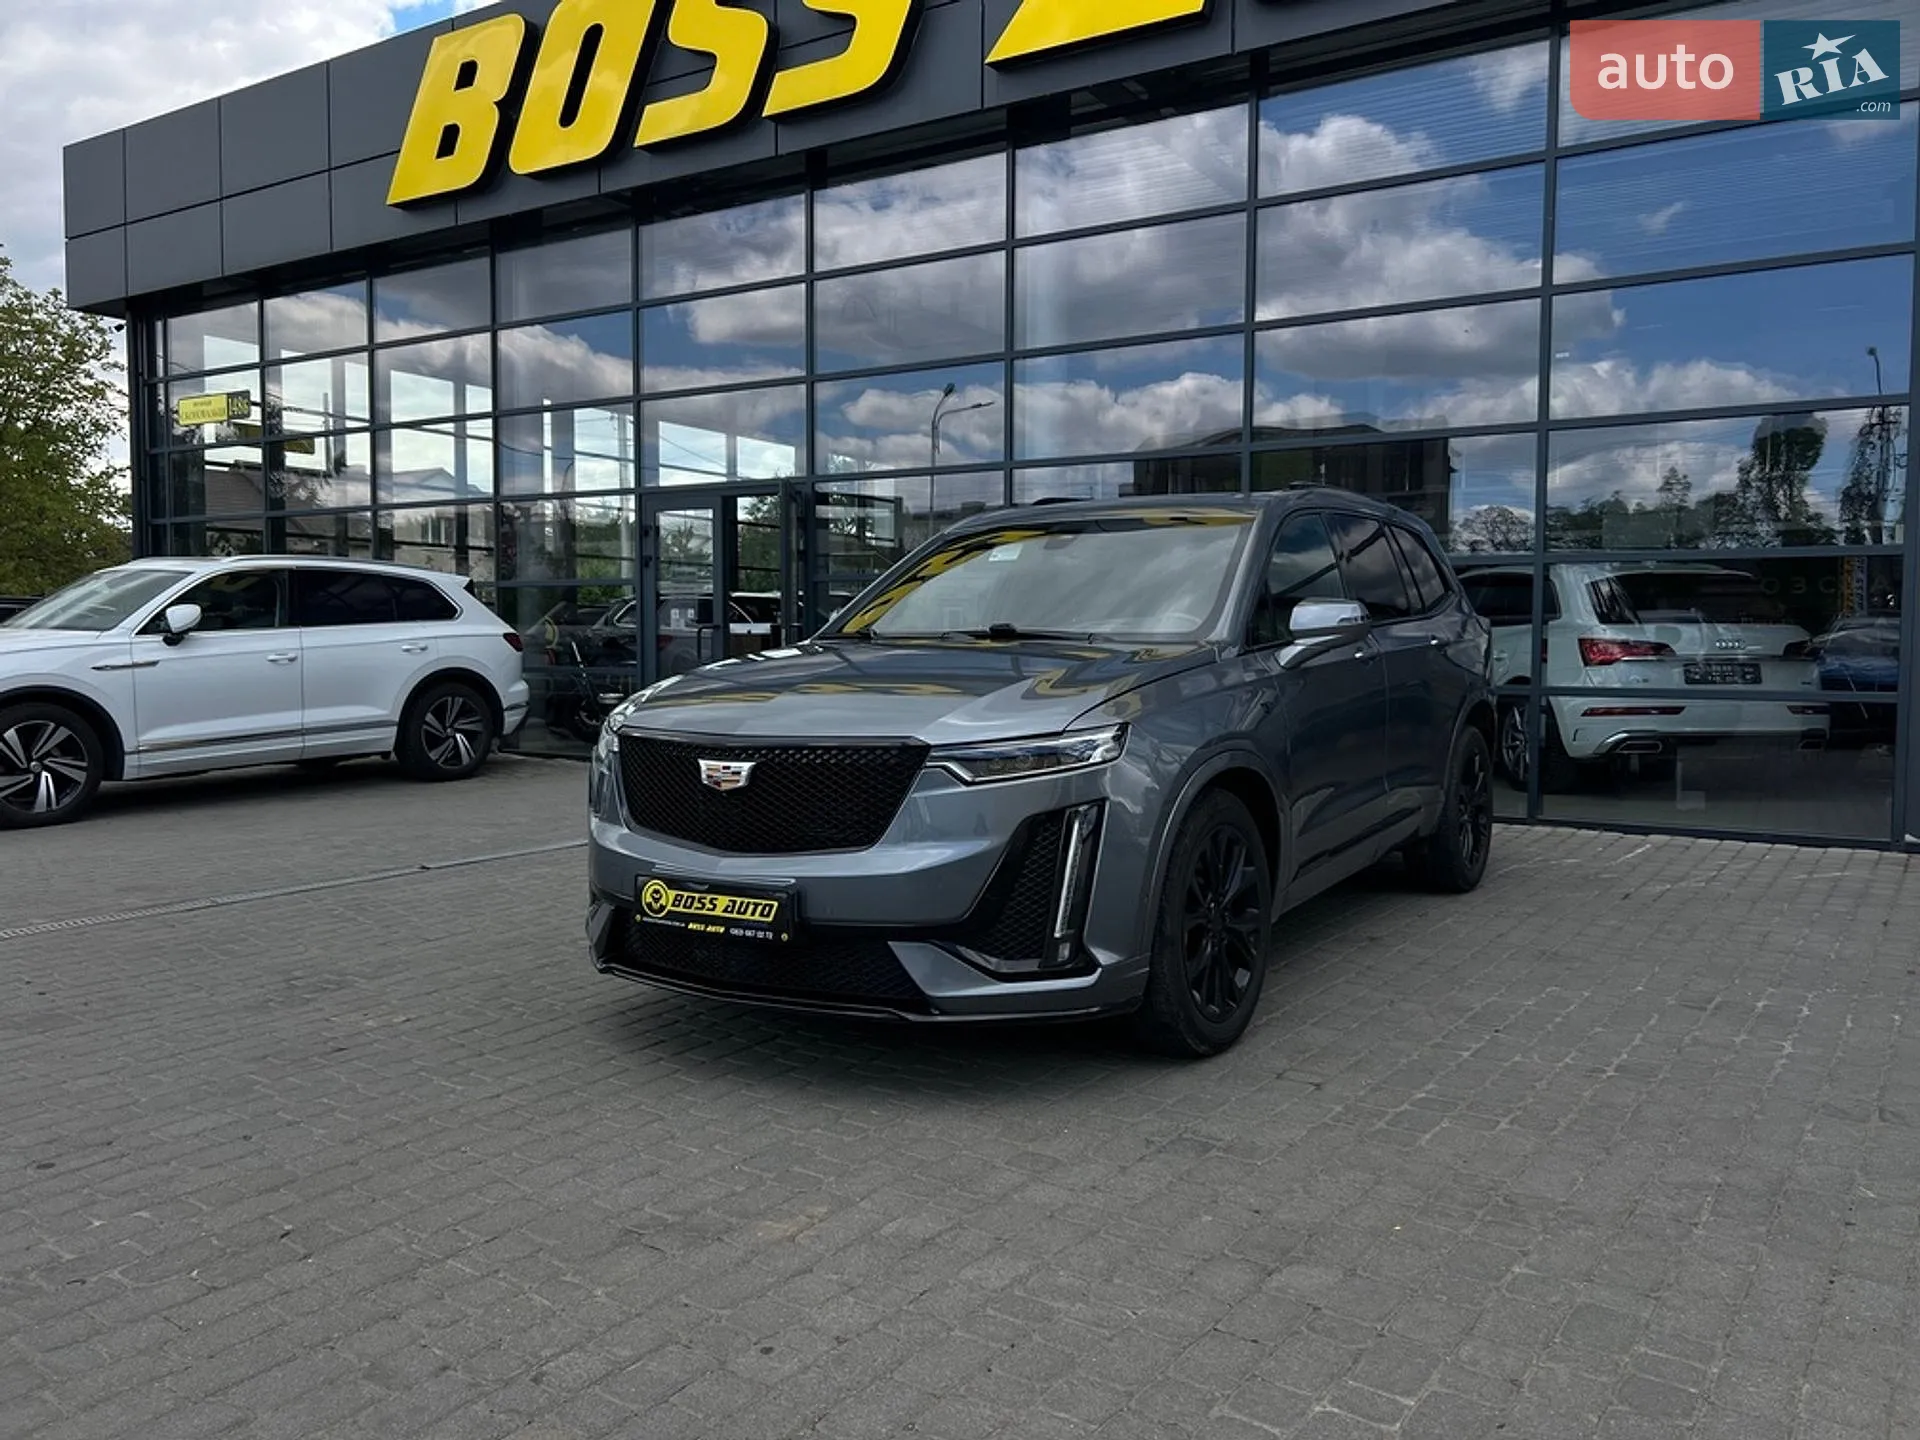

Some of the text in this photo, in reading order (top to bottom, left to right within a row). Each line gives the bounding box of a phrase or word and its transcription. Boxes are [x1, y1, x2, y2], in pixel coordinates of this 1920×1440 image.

[387, 0, 914, 206] BOSS
[672, 894, 775, 918] BOSS AUTO
